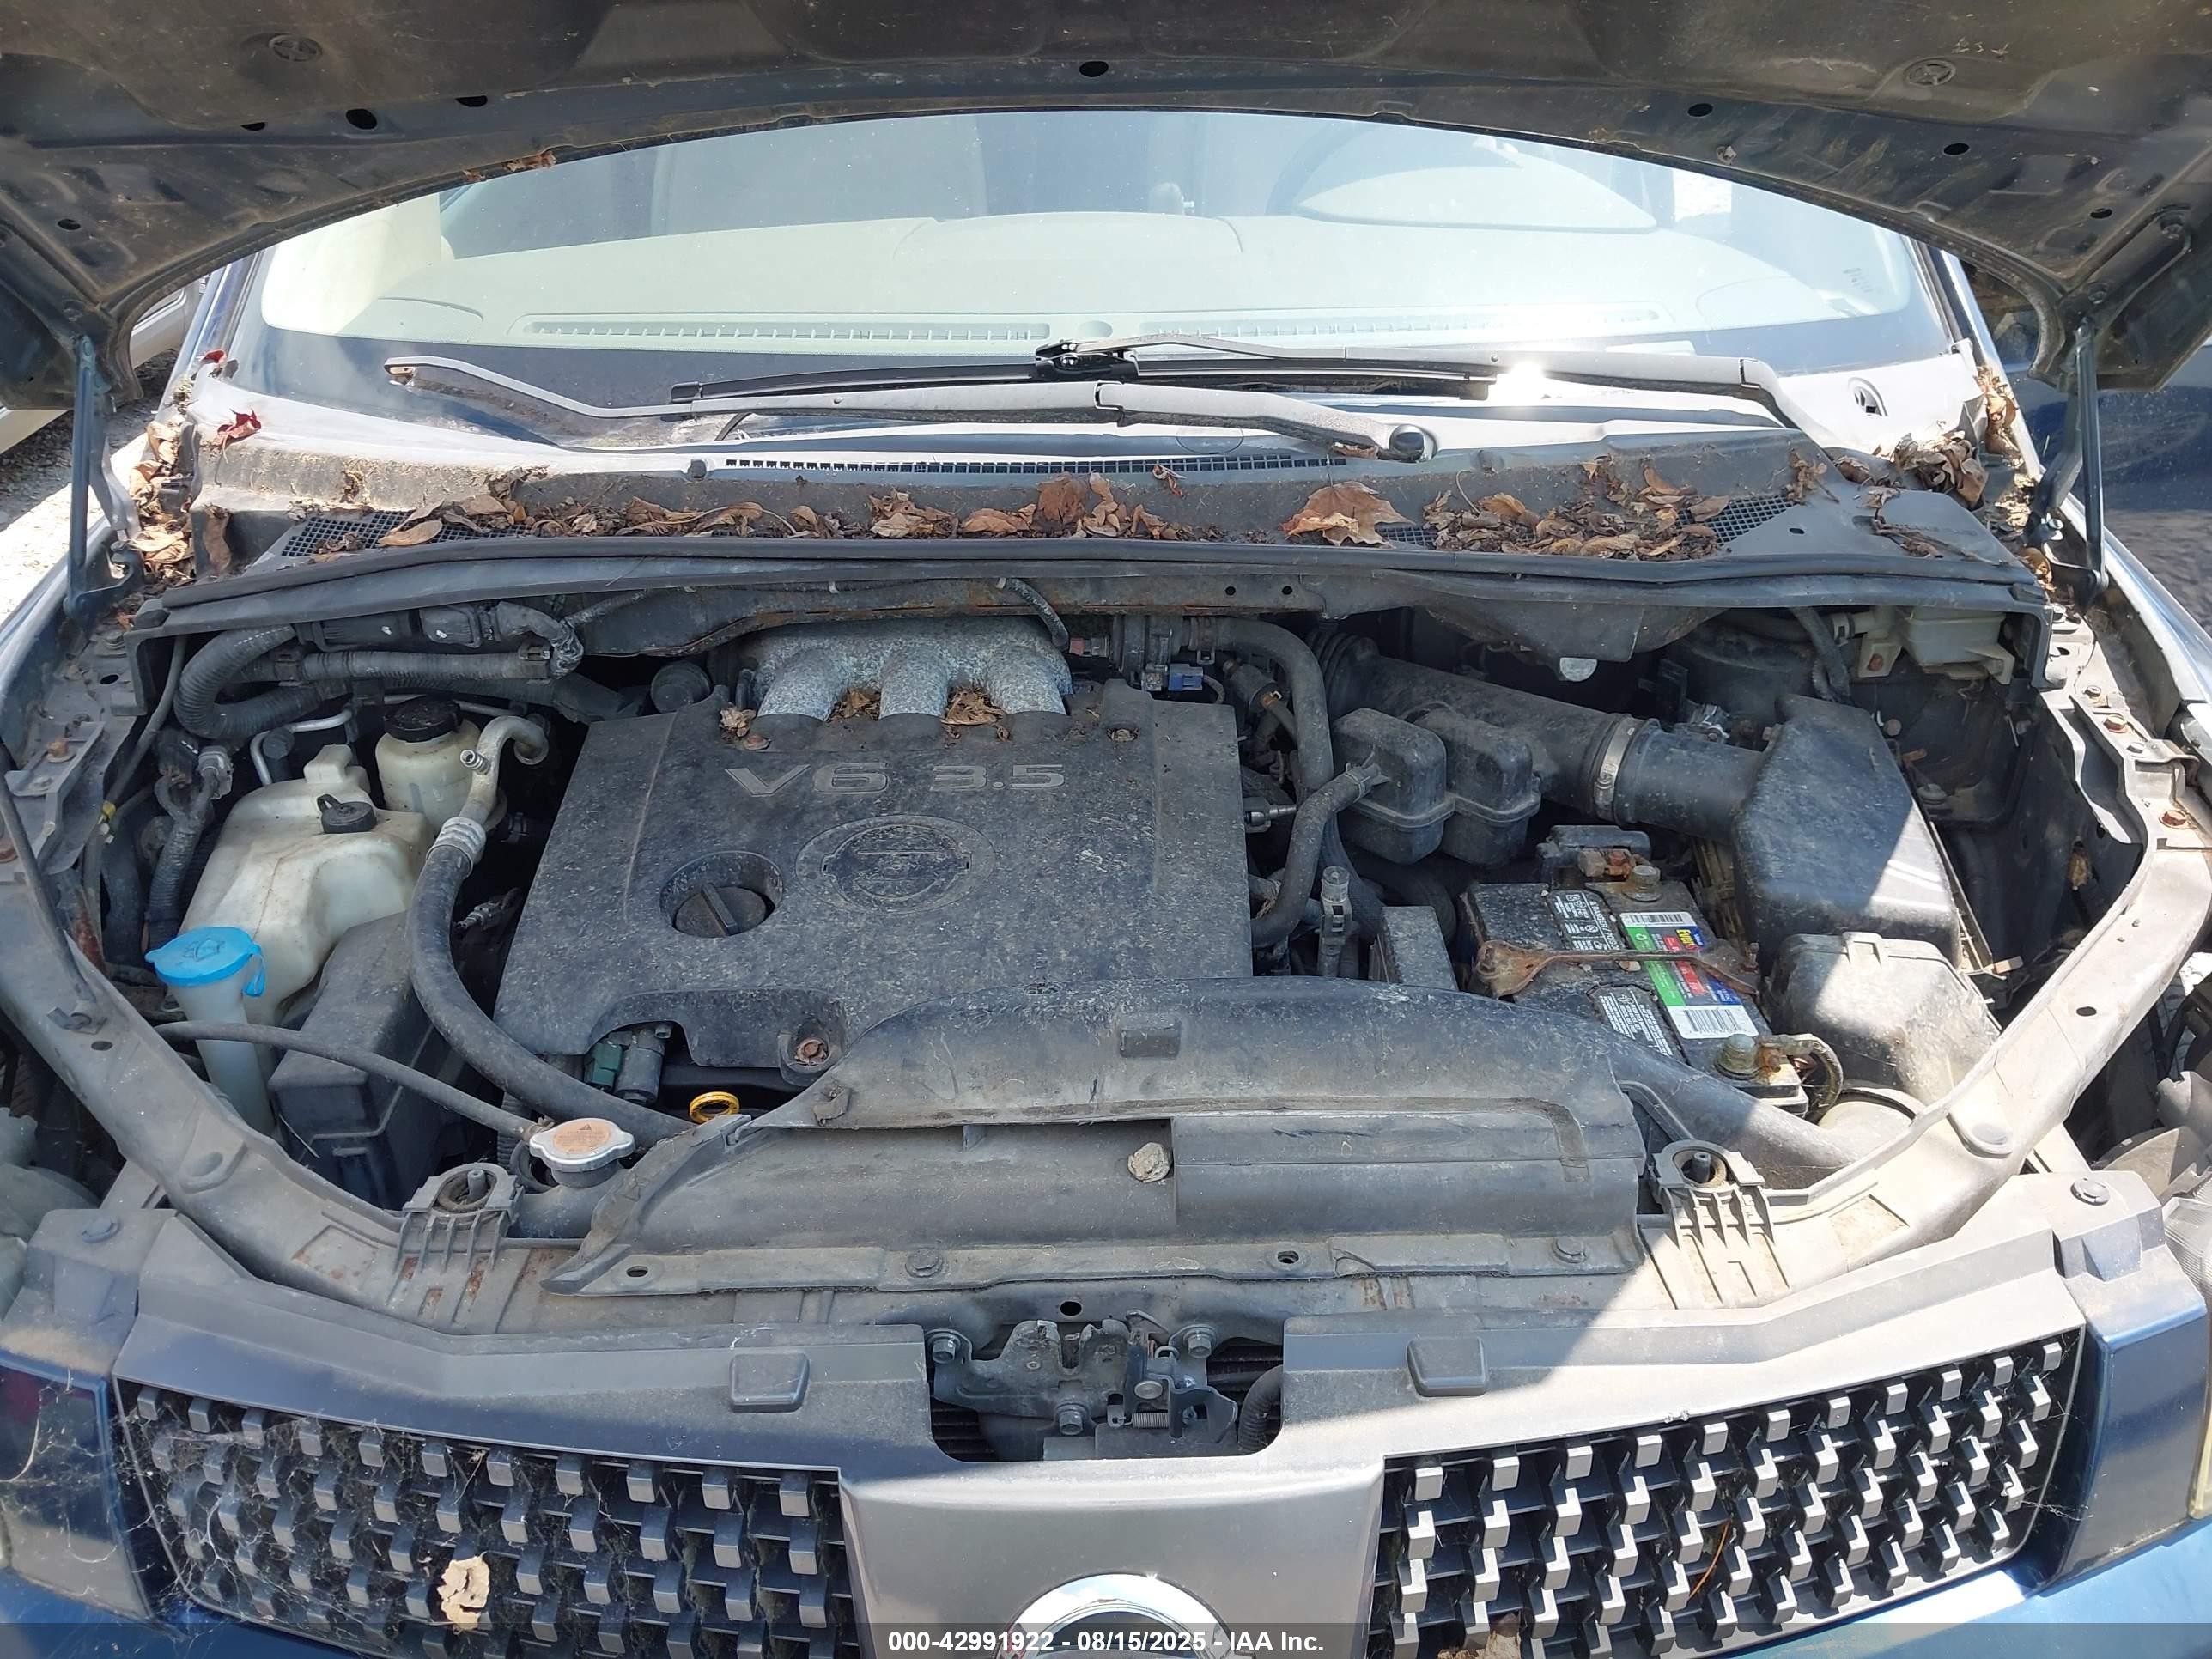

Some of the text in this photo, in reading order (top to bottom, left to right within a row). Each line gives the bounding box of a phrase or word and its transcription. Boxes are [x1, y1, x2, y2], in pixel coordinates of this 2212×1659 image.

[724, 762, 1066, 796] V6 3.5
[1591, 906, 1608, 928] DANGER
